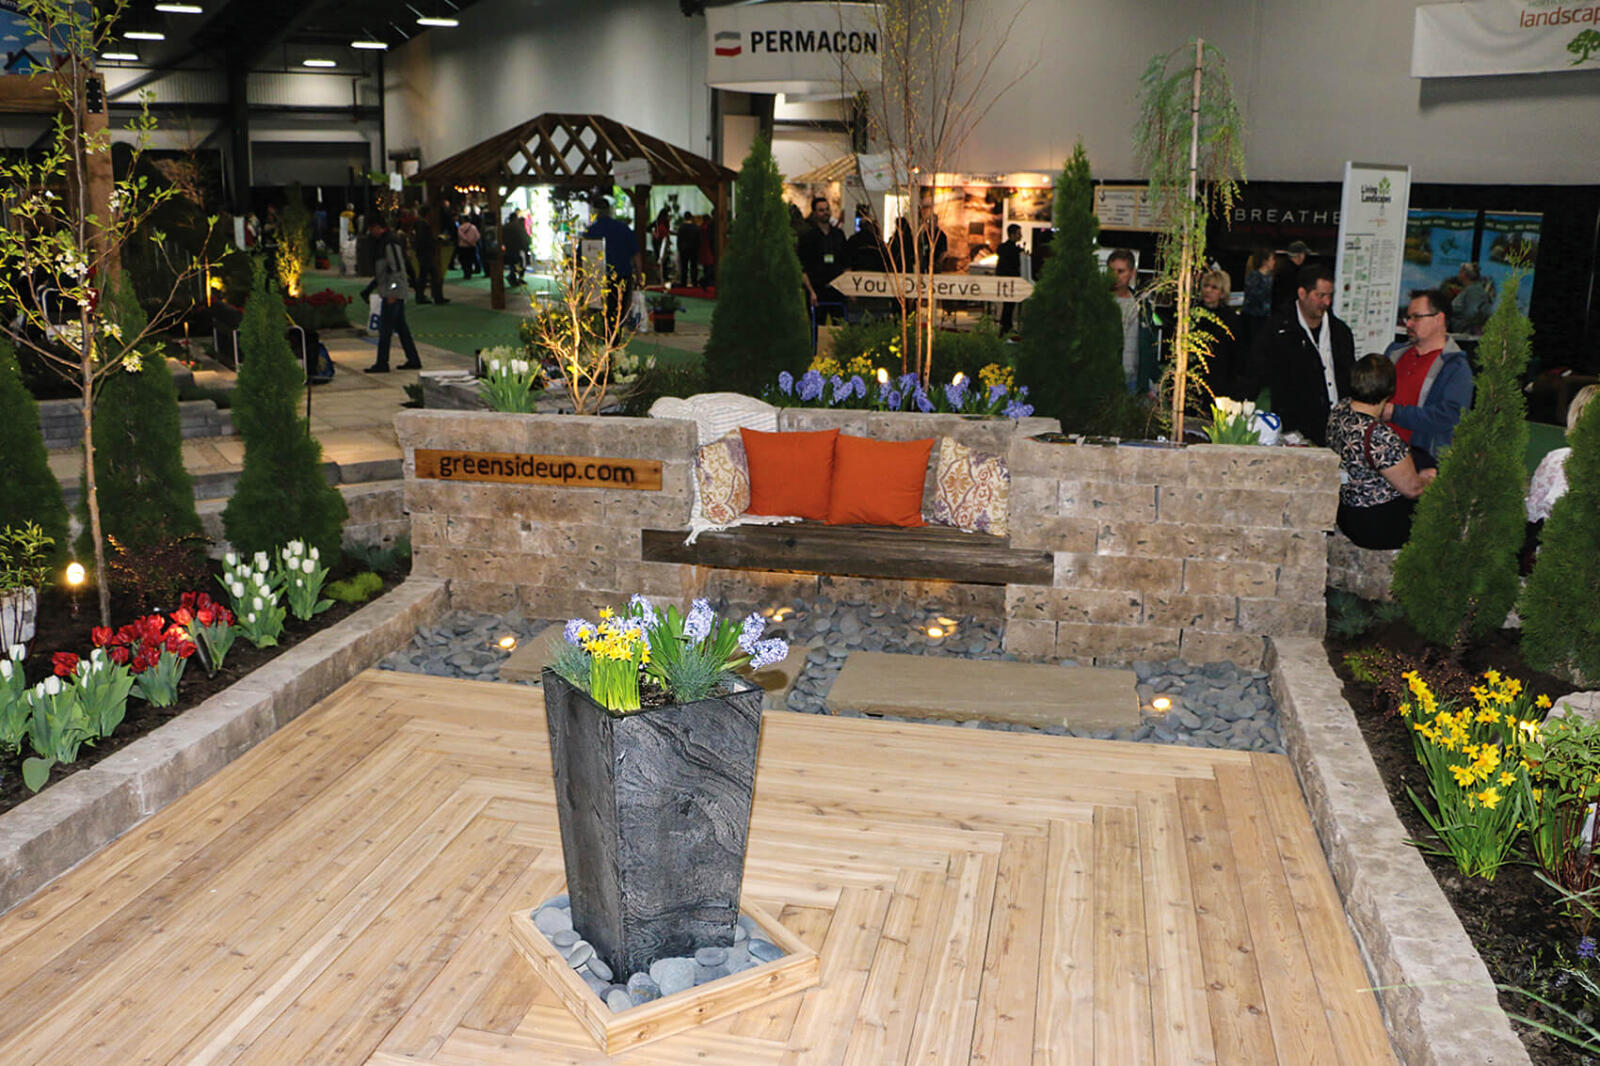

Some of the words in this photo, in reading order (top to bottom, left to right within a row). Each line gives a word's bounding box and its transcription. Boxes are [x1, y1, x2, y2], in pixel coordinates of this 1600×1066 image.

[751, 30, 877, 54] PERMACON
[852, 276, 887, 293] You
[997, 280, 1015, 298] It!
[439, 455, 635, 483] greensideup.com
